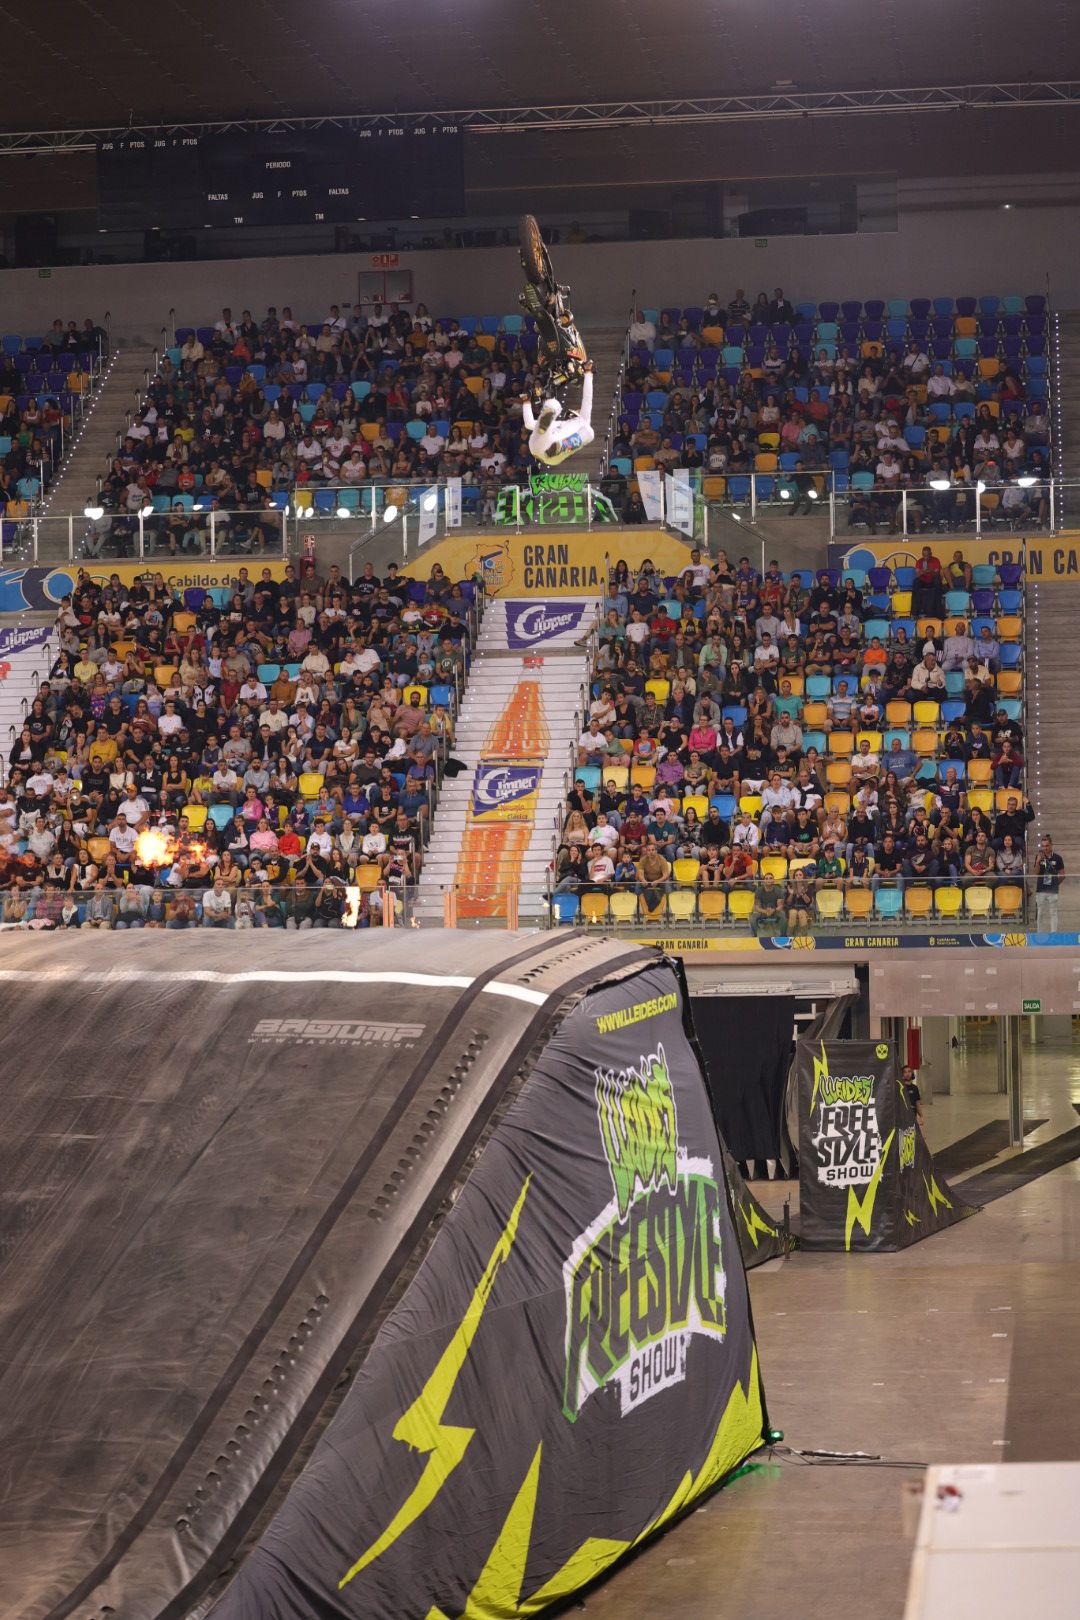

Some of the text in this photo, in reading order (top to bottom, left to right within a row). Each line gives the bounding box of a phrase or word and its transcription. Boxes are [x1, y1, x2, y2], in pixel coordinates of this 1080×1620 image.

[389, 128, 403, 136] PTOS
[414, 127, 426, 135] JUG
[130, 141, 145, 149] PTOS
[183, 138, 198, 146] PTOS
[265, 161, 291, 169] PERIODO
[291, 189, 307, 197] PTOS
[523, 544, 569, 567] GRAN
[168, 574, 218, 587] Cabildo
[524, 566, 598, 588] CANARIA
[514, 604, 574, 641] Clipper
[0, 627, 46, 652] lipper
[477, 766, 536, 806] Clipper
[655, 939, 675, 950] GRAN
[845, 937, 899, 947] GRAN CANARIA
[597, 992, 678, 1034] WWW.LLEIDES.COM
[1023, 1002, 1040, 1010] SALIDA
[253, 1018, 426, 1041] BAGJUMP
[817, 1132, 880, 1167] STYLE
[826, 1166, 874, 1181] SHOW
[629, 1335, 678, 1402] SHOW
